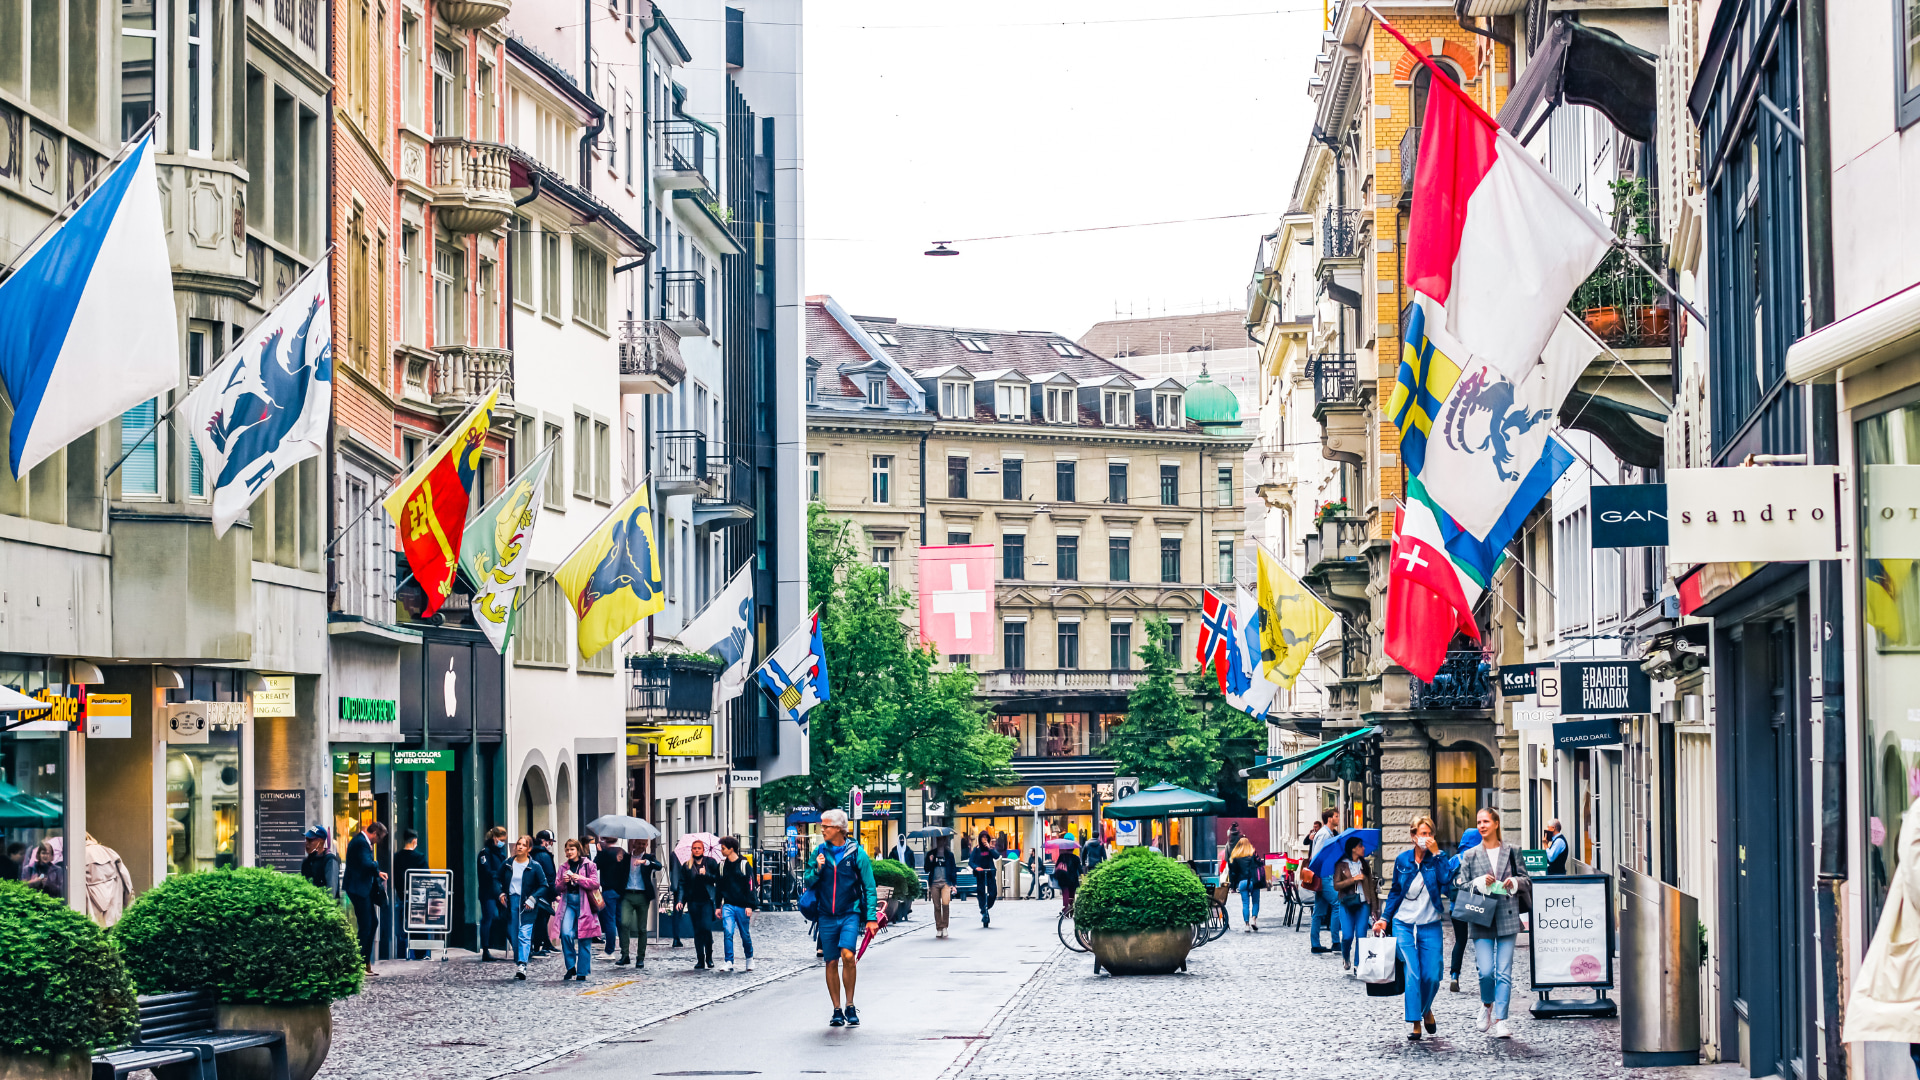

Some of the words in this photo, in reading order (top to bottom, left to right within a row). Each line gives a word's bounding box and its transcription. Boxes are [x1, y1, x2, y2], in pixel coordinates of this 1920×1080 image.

[1600, 510, 1668, 522] GAN
[1682, 504, 1824, 524] sandro
[1589, 666, 1628, 687] BARBER
[265, 692, 290, 700] REALTY
[1583, 687, 1629, 709] PARADOX
[1516, 709, 1555, 722] maje
[665, 728, 703, 750] Honold
[1560, 735, 1589, 743] GERARD
[1589, 732, 1612, 740] DAREL
[1464, 903, 1485, 914] ecco
[1545, 895, 1576, 912] pret
[1538, 912, 1594, 929] beaute
